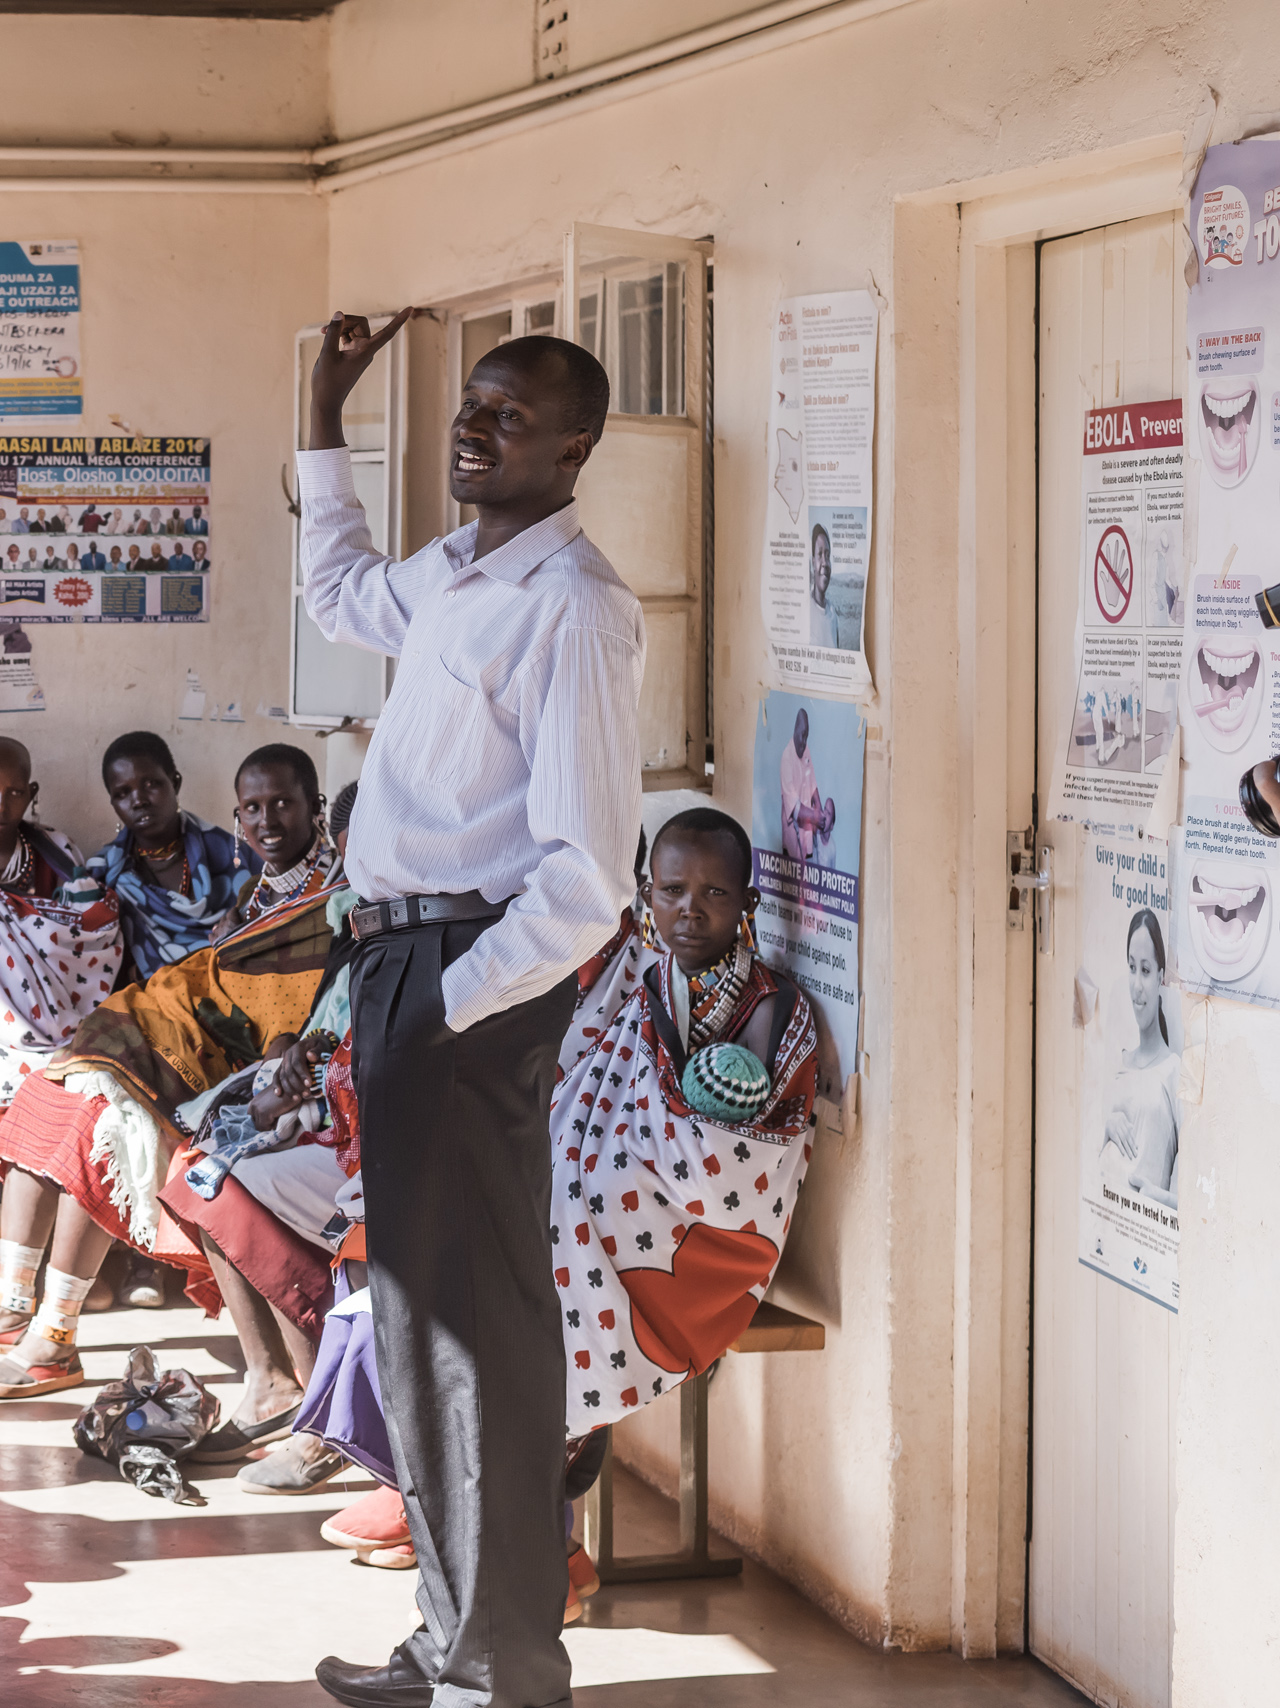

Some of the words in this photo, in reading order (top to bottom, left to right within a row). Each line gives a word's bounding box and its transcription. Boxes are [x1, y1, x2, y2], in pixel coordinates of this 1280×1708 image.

[1204, 193, 1222, 202] Colgate
[1204, 204, 1222, 214] BRIGHT
[1223, 201, 1242, 212] SMILES,
[1204, 214, 1220, 224] BRIGHT
[1222, 211, 1244, 222] FUTURES
[1254, 214, 1280, 264] TO
[38, 273, 54, 282] ZA
[20, 286, 56, 296] UZAZI
[59, 286, 76, 294] ZA
[8, 297, 78, 307] OUTREACH
[1199, 339, 1204, 348] 3.
[1206, 336, 1220, 348] WAY
[1222, 336, 1229, 346] IN
[1230, 334, 1243, 344] THE
[1244, 332, 1262, 343] BACK
[1198, 352, 1212, 361] Brush
[1212, 350, 1232, 362] chewing
[1233, 348, 1250, 358] surface
[1250, 348, 1256, 356] of
[1198, 364, 1208, 372] each
[1210, 363, 1224, 372] tooth.
[1086, 411, 1135, 448] EBOLA
[52, 438, 95, 452] LAND
[100, 438, 160, 452] ABLAZE
[166, 438, 204, 452] 2016
[36, 455, 84, 466] ANNUAL
[87, 455, 122, 466] MEGA
[124, 455, 202, 466] CONFERENCE
[1102, 460, 1112, 470] Ebola
[1120, 459, 1138, 468] severe
[1138, 457, 1150, 466] and
[1150, 456, 1164, 466] often
[1164, 454, 1184, 465] deadly
[18, 468, 58, 482] Host:
[63, 468, 117, 482] Olosho
[122, 468, 206, 482] LOOLOITAI
[1102, 475, 1117, 484] disease
[1118, 472, 1134, 484] caused
[1134, 472, 1142, 484] by
[1144, 472, 1152, 482] the
[1152, 470, 1168, 481] Ebola
[1168, 470, 1184, 480] virus.
[1214, 580, 1218, 589] 2.
[1220, 580, 1241, 590] NSIDE
[1196, 594, 1211, 602] Brush
[1212, 595, 1225, 603] inside
[1226, 595, 1244, 604] surface
[1244, 596, 1250, 604] of
[1196, 607, 1208, 615] each
[1210, 607, 1224, 616] tooth,
[1224, 608, 1237, 618] using
[1238, 608, 1260, 618] wiggling
[1196, 619, 1220, 628] technique
[1222, 620, 1226, 628] in
[1226, 620, 1238, 629] Step
[1187, 816, 1204, 826] Place
[1205, 817, 1222, 828] brush
[1223, 820, 1229, 829] at
[1230, 822, 1246, 832] angle
[1186, 830, 1212, 840] gumline.
[1213, 832, 1232, 843] Wiggle
[1234, 834, 1251, 846] gently
[1252, 836, 1266, 846] back
[1267, 838, 1277, 848] and
[1185, 840, 1201, 850] forth.
[1202, 842, 1224, 854] Repeat
[1225, 846, 1234, 854] for
[1234, 848, 1248, 857] each
[1250, 850, 1266, 860] tooth.
[1096, 845, 1114, 867] Give
[1116, 852, 1136, 874] your
[1138, 852, 1158, 877] child
[1160, 862, 1165, 878] a
[759, 852, 802, 881] VACCINATE
[802, 863, 820, 885] AND
[821, 871, 856, 897] PROTECT
[759, 874, 782, 892] CHILDREN
[782, 880, 798, 896] UNDER
[799, 884, 803, 897] 5
[802, 885, 819, 904] YEARS
[820, 892, 841, 910] AGAINST
[842, 899, 855, 915] POLIO
[1112, 875, 1124, 900] for
[1126, 883, 1148, 908] good
[1150, 884, 1168, 912] heal
[760, 898, 777, 917] Health
[778, 903, 794, 921] teams
[794, 906, 803, 923] will
[804, 910, 816, 929] visit
[816, 917, 829, 936] your
[830, 918, 846, 938] house
[846, 928, 852, 942] to
[760, 928, 784, 948] vaccinate
[785, 940, 796, 956] your
[798, 940, 810, 958] child
[812, 946, 831, 968] against
[832, 953, 846, 972] polio.
[799, 973, 822, 993] vaccines
[823, 981, 832, 996] are
[832, 983, 844, 1002] safe
[844, 989, 854, 1006] and
[1103, 1184, 1120, 1204] Ensure
[1120, 1196, 1130, 1209] you
[1132, 1200, 1141, 1214] are
[1142, 1204, 1159, 1222] tested
[1160, 1210, 1168, 1226] for
